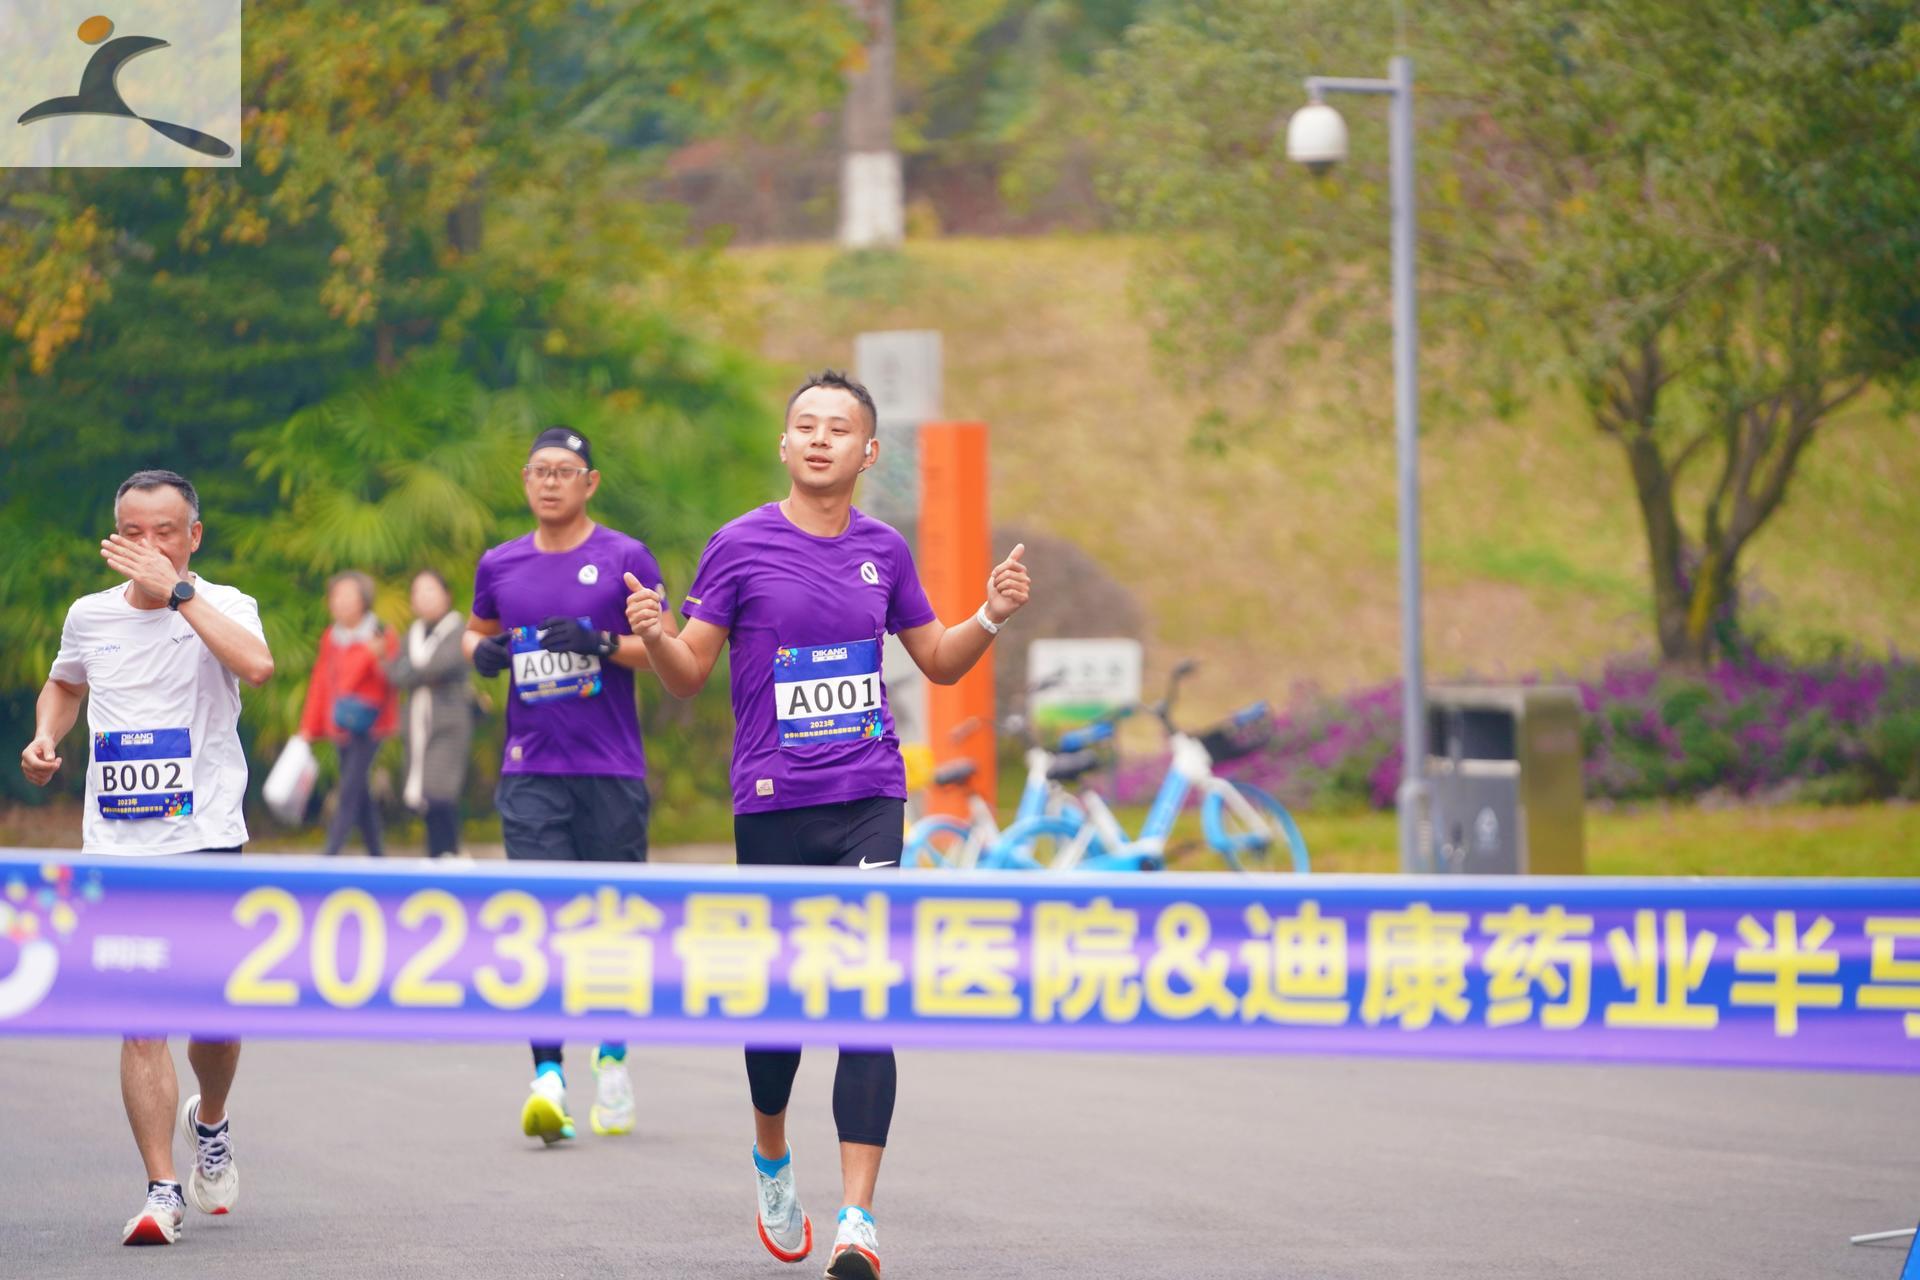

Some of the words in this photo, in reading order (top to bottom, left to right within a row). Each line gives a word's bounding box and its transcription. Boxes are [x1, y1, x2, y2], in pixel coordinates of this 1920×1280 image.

[523, 651, 591, 679] A003
[788, 677, 875, 716] A001
[102, 762, 183, 792] B002
